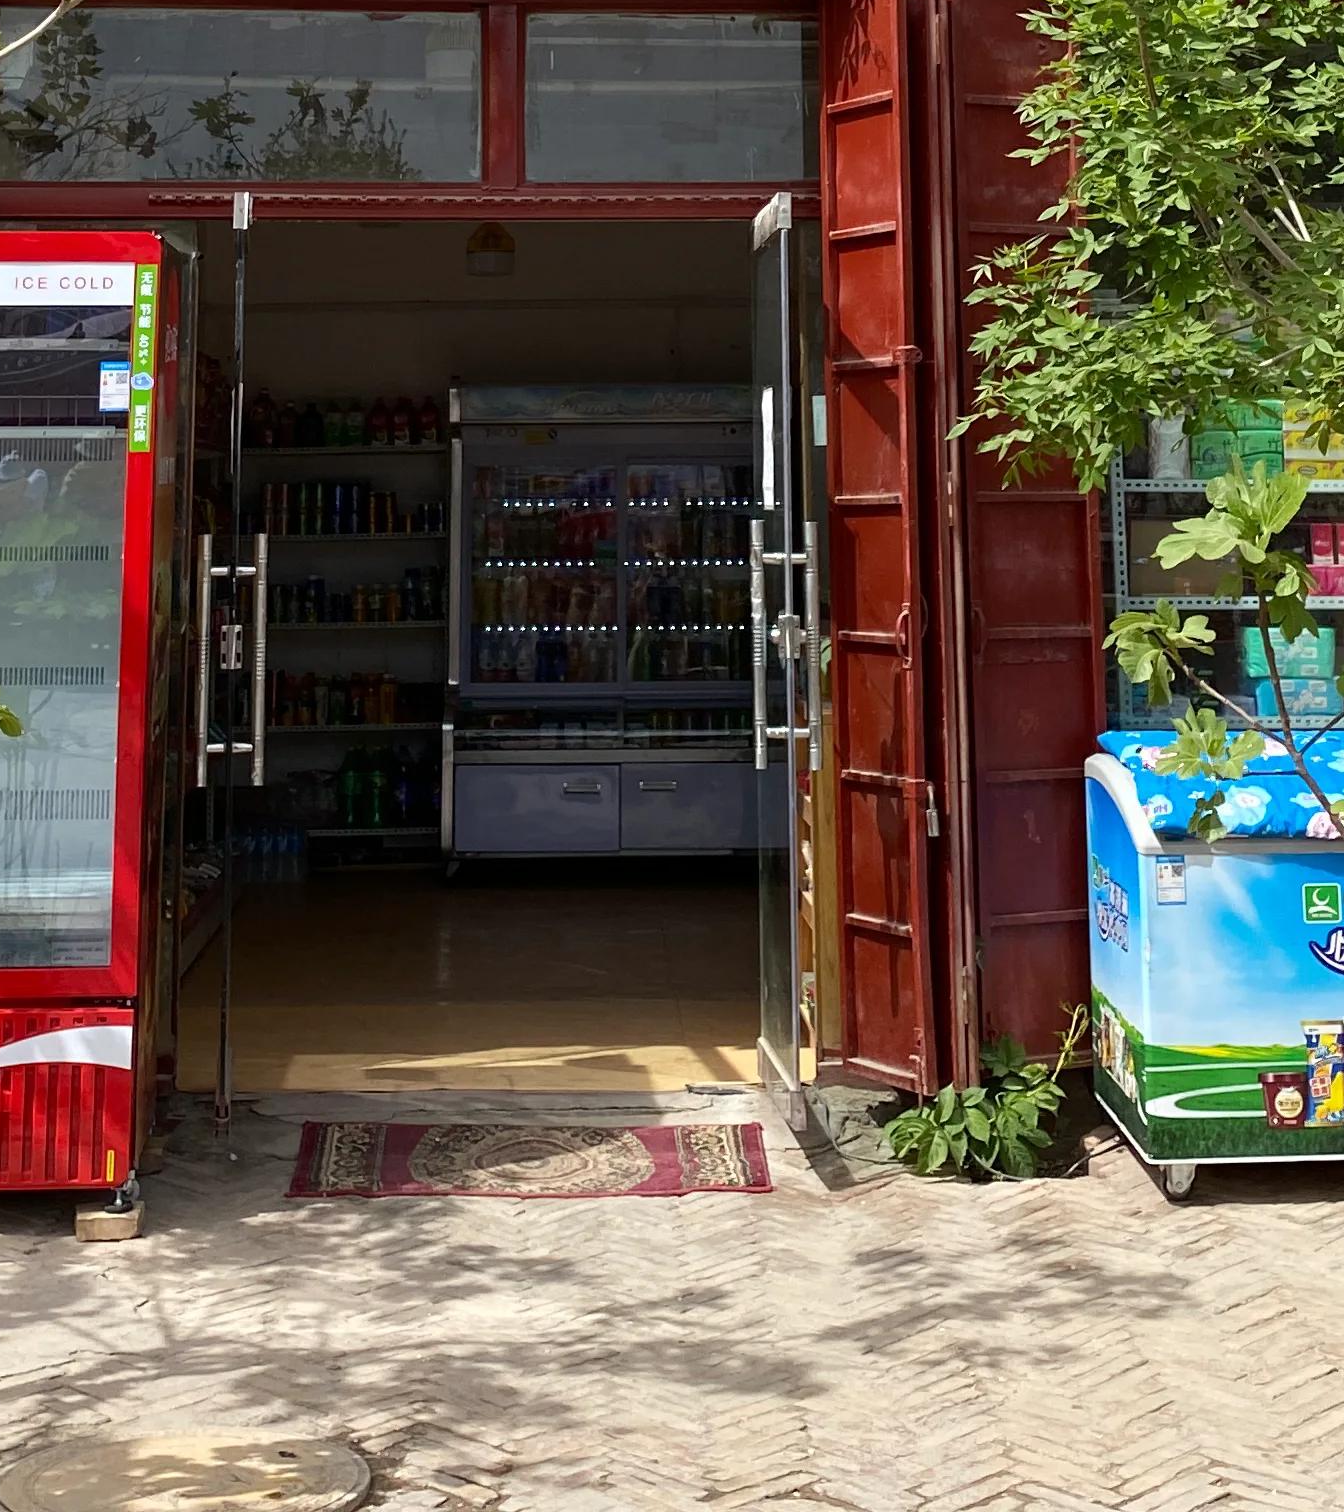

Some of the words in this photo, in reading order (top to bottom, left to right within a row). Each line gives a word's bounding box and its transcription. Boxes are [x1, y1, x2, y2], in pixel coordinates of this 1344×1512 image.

[14, 276, 48, 290] ICE
[59, 276, 114, 290] COLD
[133, 404, 148, 443] 更环保
